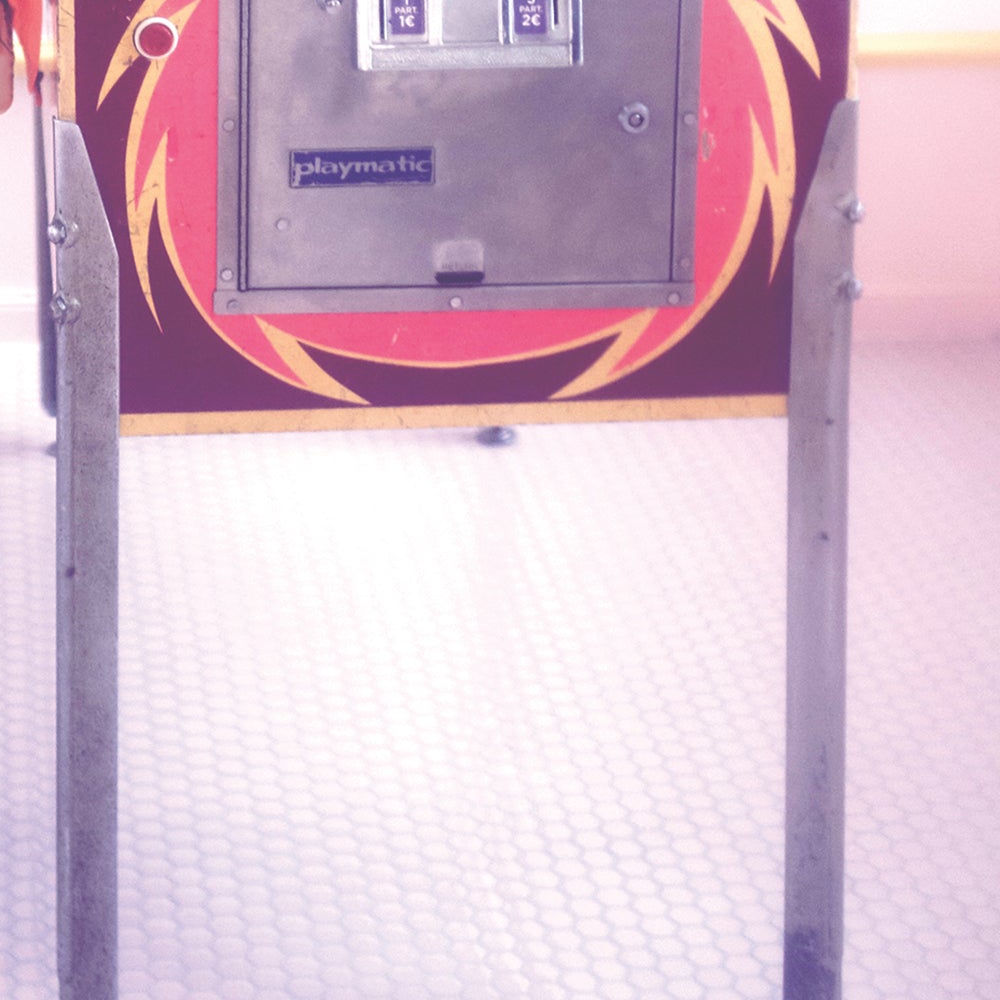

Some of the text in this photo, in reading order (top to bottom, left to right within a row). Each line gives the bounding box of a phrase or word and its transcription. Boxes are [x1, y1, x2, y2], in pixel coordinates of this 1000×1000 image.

[395, 6, 419, 14] PART.
[519, 5, 543, 13] PART.
[400, 15, 415, 28] 1€
[522, 15, 541, 27] 2€
[293, 155, 431, 186] playmatic
